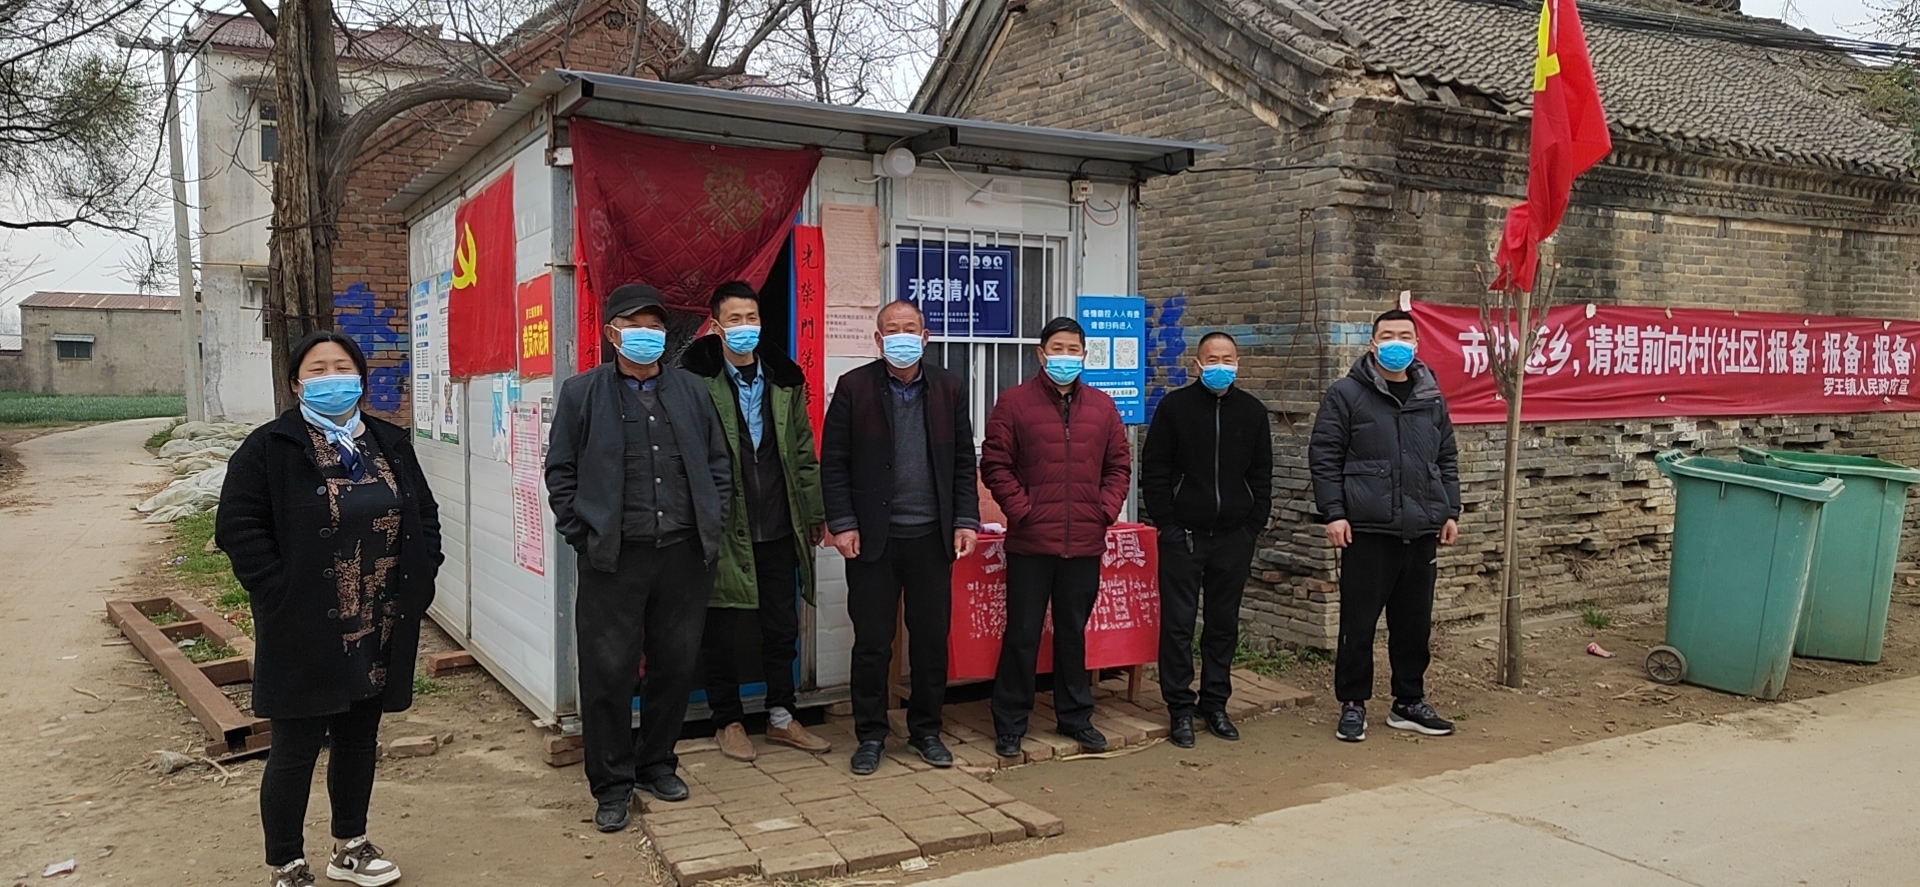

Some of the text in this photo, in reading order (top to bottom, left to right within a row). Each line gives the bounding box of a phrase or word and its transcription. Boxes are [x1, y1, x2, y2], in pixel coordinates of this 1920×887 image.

[908, 277, 1000, 301] 无疫情小区
[1823, 377, 1910, 397] 罗王镇人民政府宣
